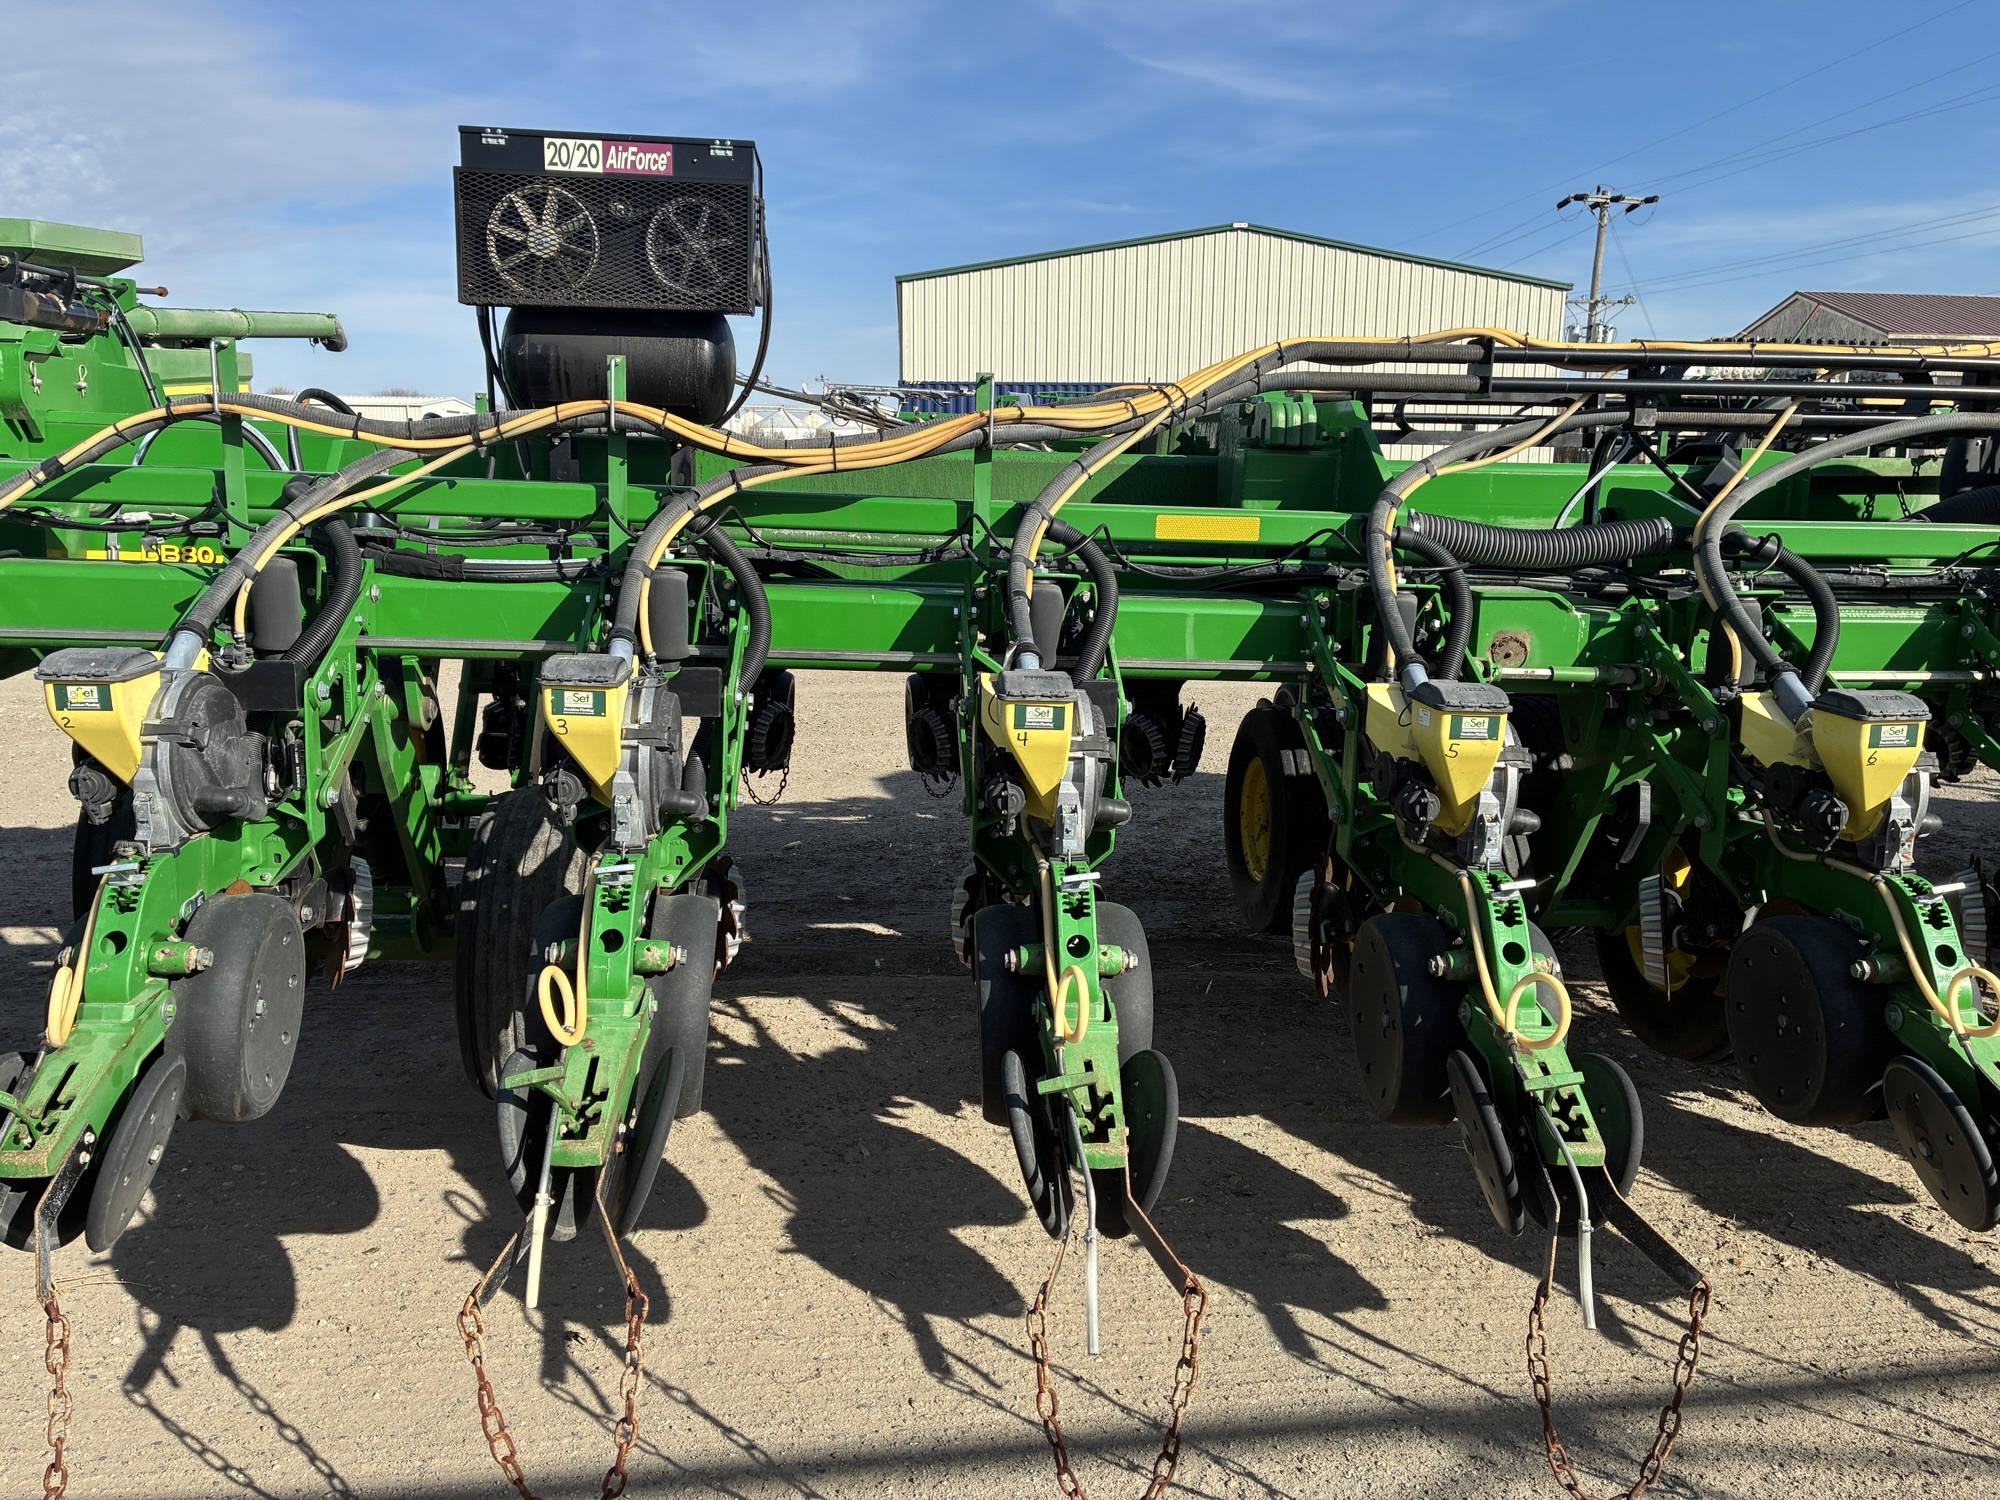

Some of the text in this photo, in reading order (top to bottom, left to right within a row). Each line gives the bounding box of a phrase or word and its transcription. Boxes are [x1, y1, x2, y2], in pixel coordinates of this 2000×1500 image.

[546, 141, 667, 172] 20/20 AirForce
[566, 692, 590, 703] eSet
[1028, 707, 1051, 718] eSet
[61, 716, 75, 728] 2
[556, 718, 569, 736] 3
[1463, 718, 1487, 728] eSet
[1882, 726, 1905, 736] eSet
[1016, 731, 1029, 747] 4
[1444, 743, 1460, 759] 5
[1866, 750, 1878, 766] 6
